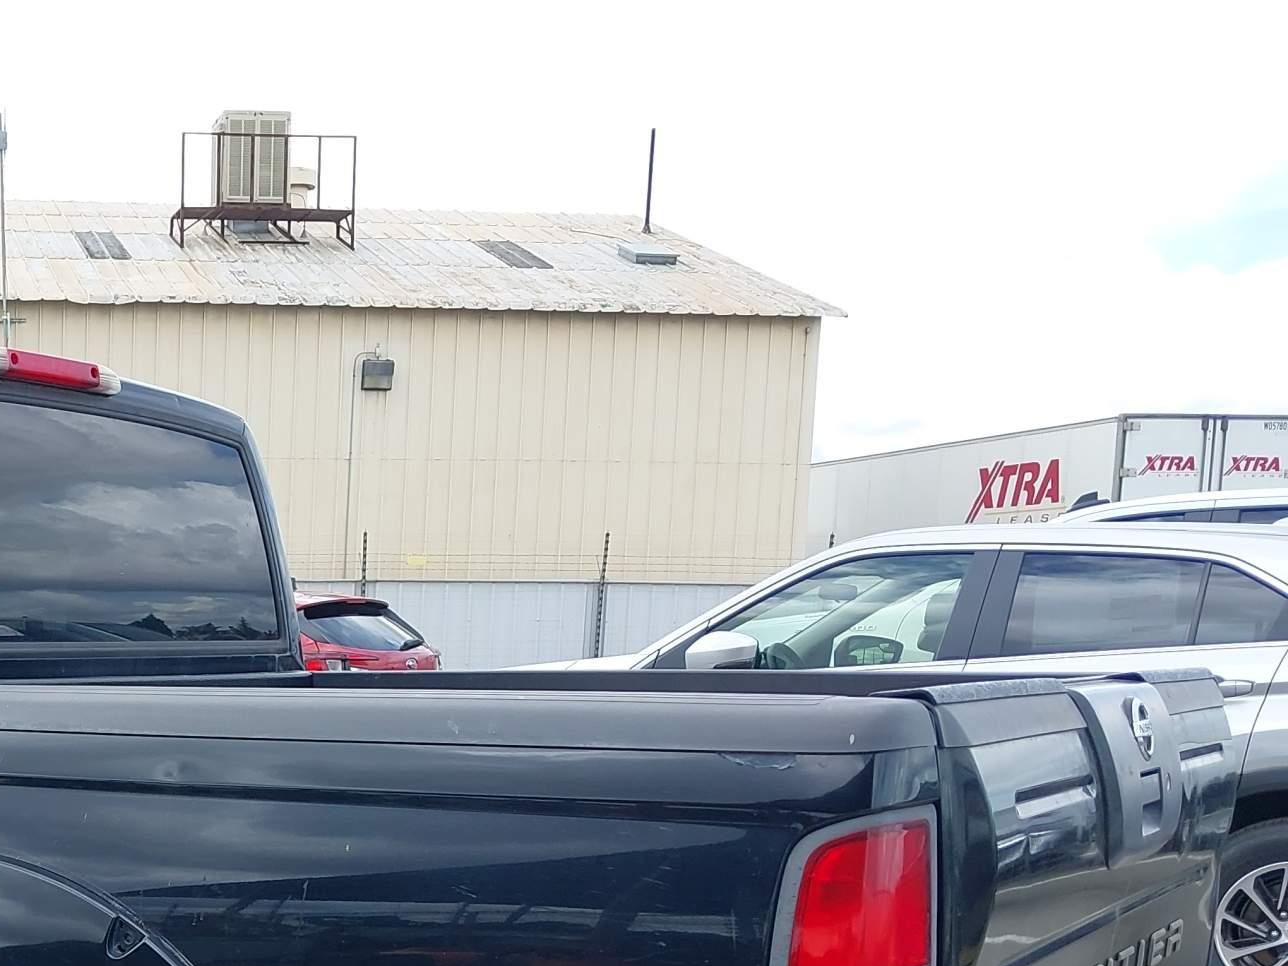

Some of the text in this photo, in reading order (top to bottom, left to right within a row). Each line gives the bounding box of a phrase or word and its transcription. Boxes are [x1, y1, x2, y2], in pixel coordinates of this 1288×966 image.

[1138, 454, 1197, 476] XTRA
[1224, 455, 1280, 477] XTRA
[965, 458, 1060, 524] XTRA
